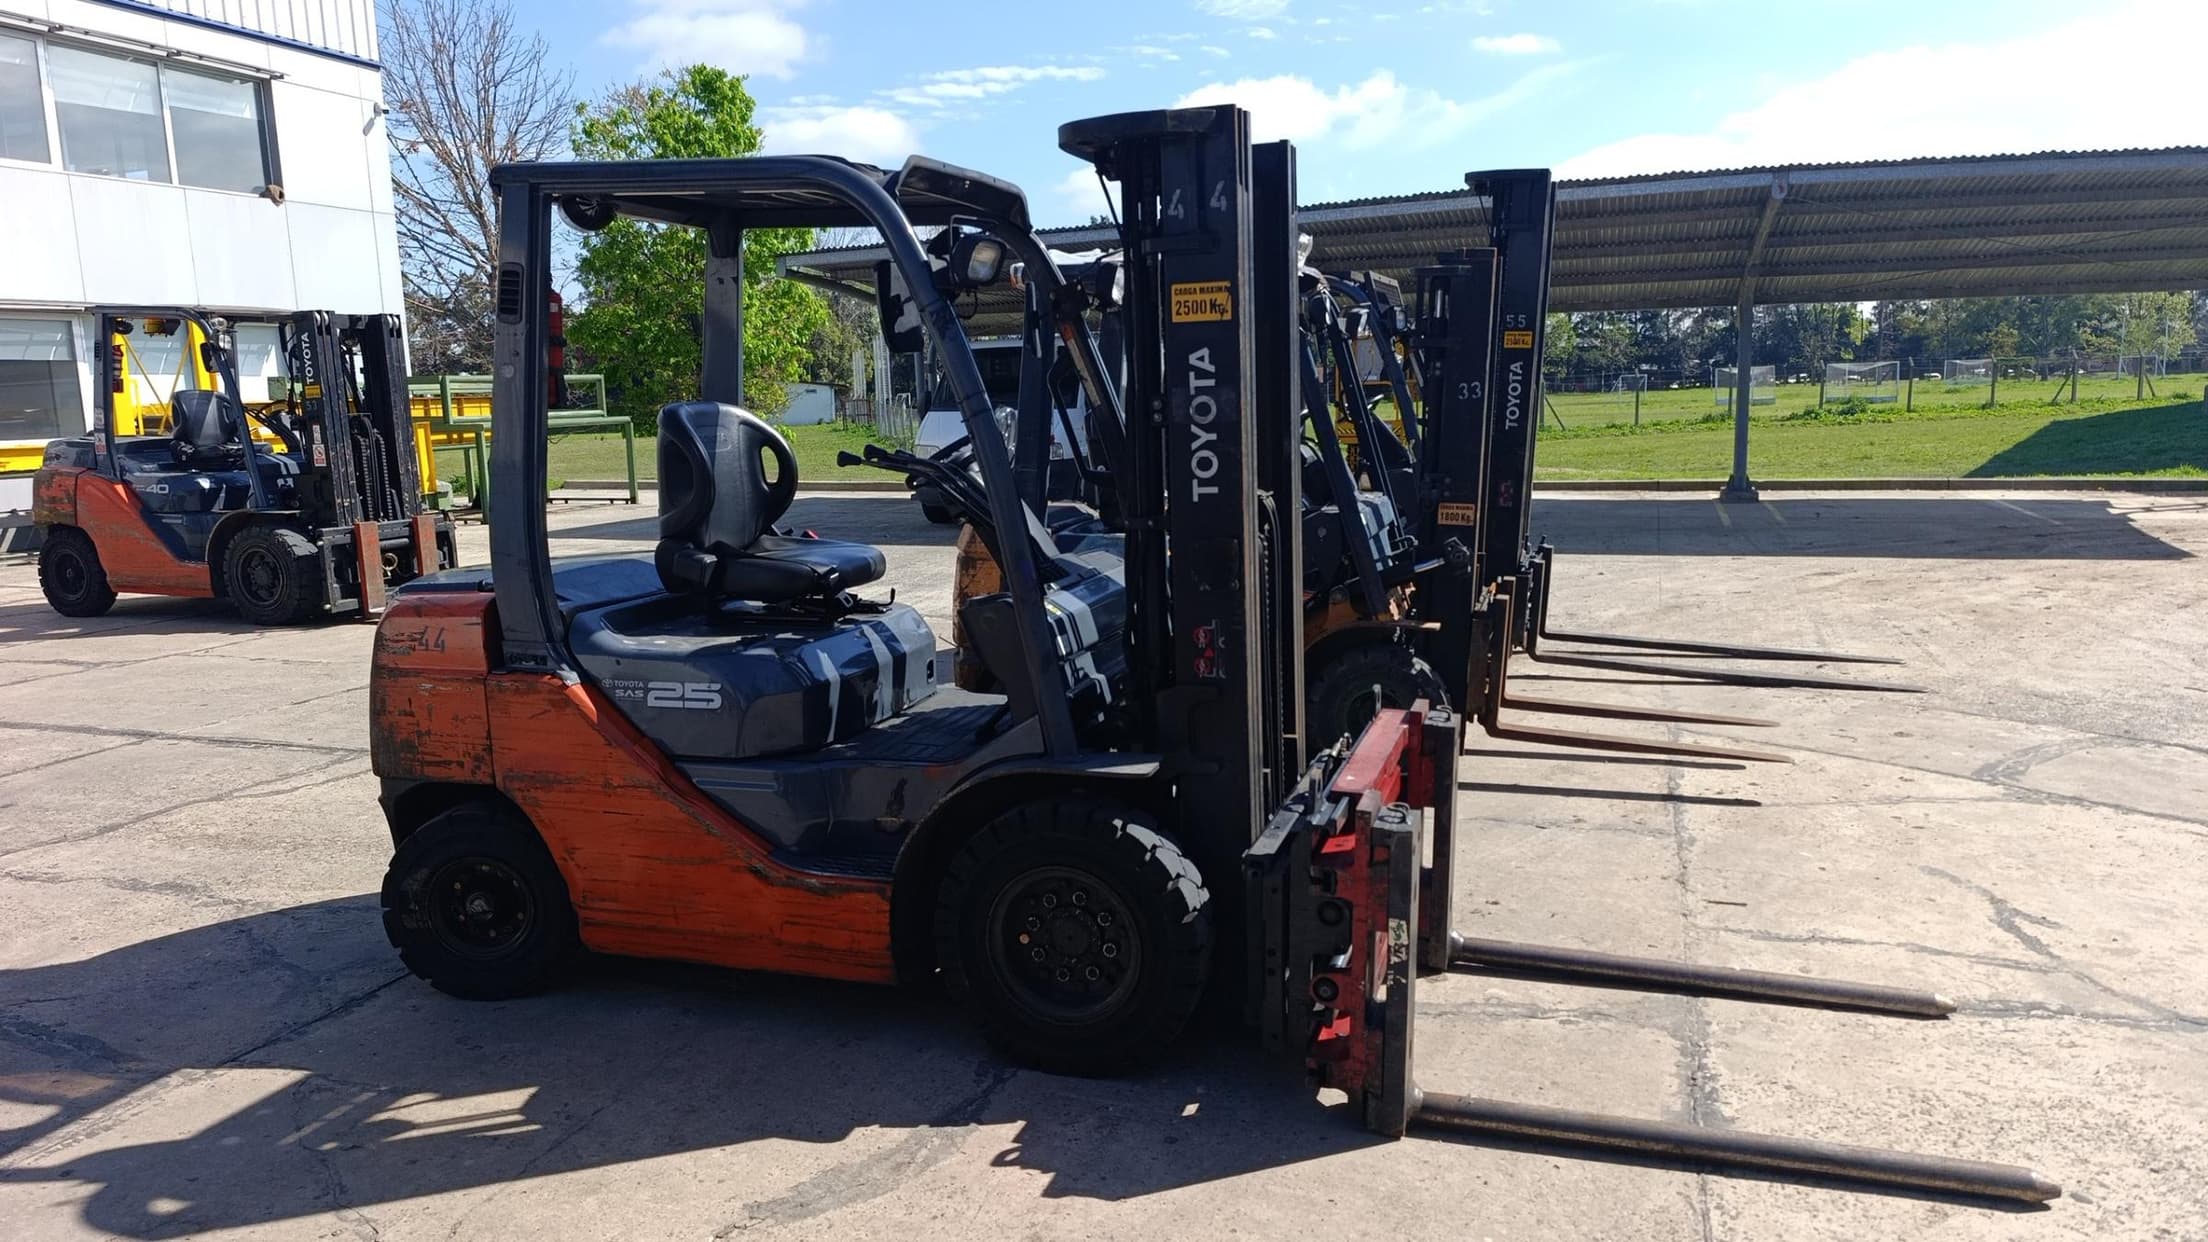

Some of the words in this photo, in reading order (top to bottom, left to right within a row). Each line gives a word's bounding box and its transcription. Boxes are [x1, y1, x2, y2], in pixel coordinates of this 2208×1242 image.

[1175, 299, 1207, 316] 2500
[1506, 314, 1527, 328] 55
[301, 332, 314, 385] TOYOTA
[1458, 381, 1481, 400] 33
[1505, 361, 1524, 430] TOYOTA
[1188, 346, 1219, 502] TOYOTA
[146, 484, 169, 494] 40
[418, 626, 446, 653] 44
[614, 680, 644, 688] TOYOTA
[615, 689, 644, 697] SAS
[647, 681, 722, 710] 25
